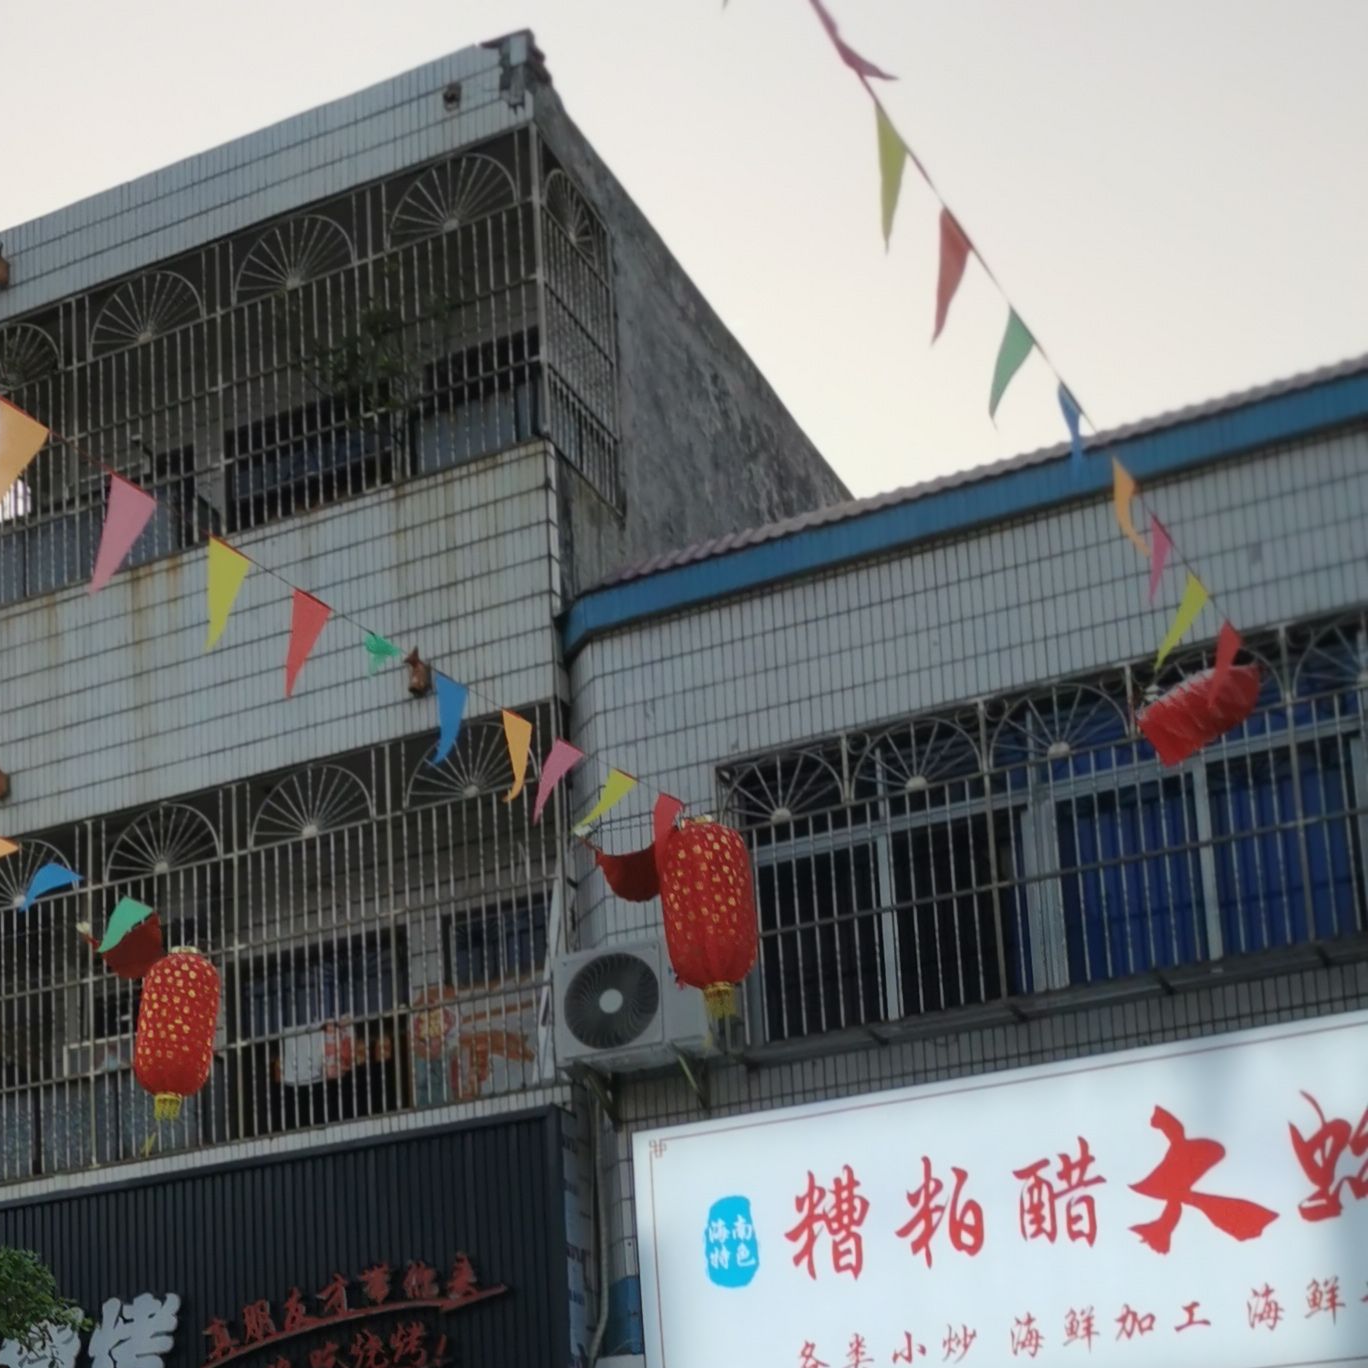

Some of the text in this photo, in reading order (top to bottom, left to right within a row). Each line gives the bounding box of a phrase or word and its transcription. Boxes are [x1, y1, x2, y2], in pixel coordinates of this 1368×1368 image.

[707, 1213, 754, 1242] 海南
[709, 1241, 757, 1271] 特色
[1008, 1301, 1213, 1357] 海鲜加工
[1246, 1274, 1368, 1331] 海鲜
